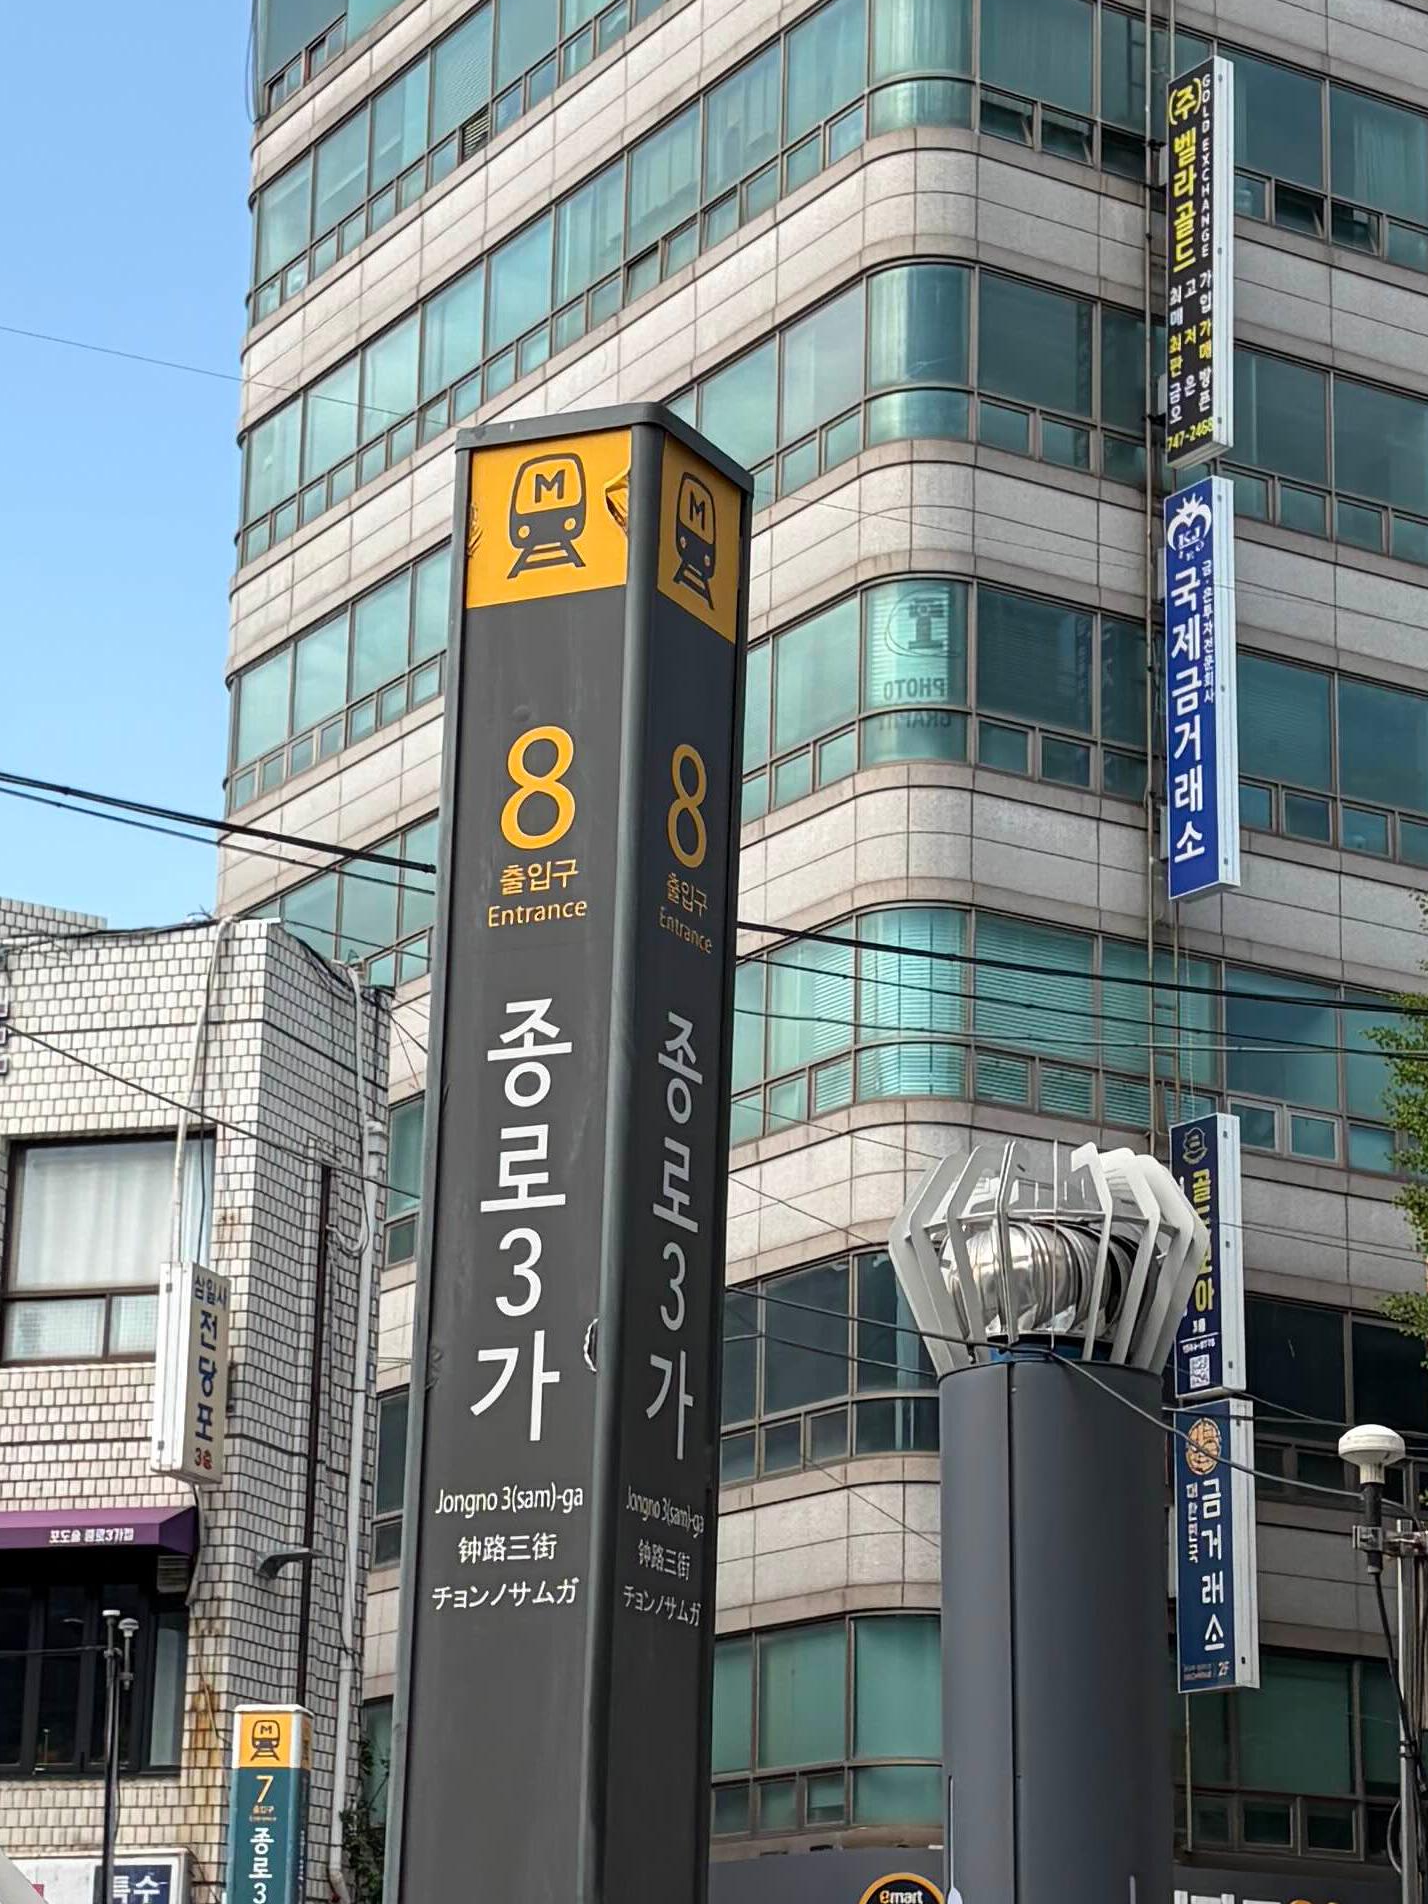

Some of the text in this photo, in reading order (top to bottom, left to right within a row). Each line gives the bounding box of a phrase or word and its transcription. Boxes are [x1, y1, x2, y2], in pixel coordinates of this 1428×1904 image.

[1201, 73, 1212, 258] GOLD EXCHANGE
[535, 468, 564, 500] M
[1171, 565, 1206, 863] 국제금거래소
[499, 725, 576, 850] 8
[666, 743, 709, 868] 8
[499, 858, 580, 895] 출입구
[665, 871, 709, 917] 출입구
[488, 896, 588, 928] Entrance
[659, 905, 714, 955] Entrance
[470, 997, 572, 1441] 종로3가
[646, 1010, 704, 1461] 종로3가
[194, 1275, 228, 1312] 삼일사
[195, 1310, 217, 1442] 전당포
[435, 1481, 584, 1519] Jongno 3(sam)-ga
[626, 1485, 705, 1538] Jongno 3(sam)-ga
[458, 1532, 557, 1564] 钟路三街
[637, 1538, 690, 1582] 钟路三街
[1202, 1477, 1224, 1651] 금거래소
[432, 1577, 579, 1609] チョンノサムガ
[622, 1584, 702, 1627] チョンノサムガ
[256, 1775, 274, 1803] 7
[880, 1890, 923, 1904] emart
